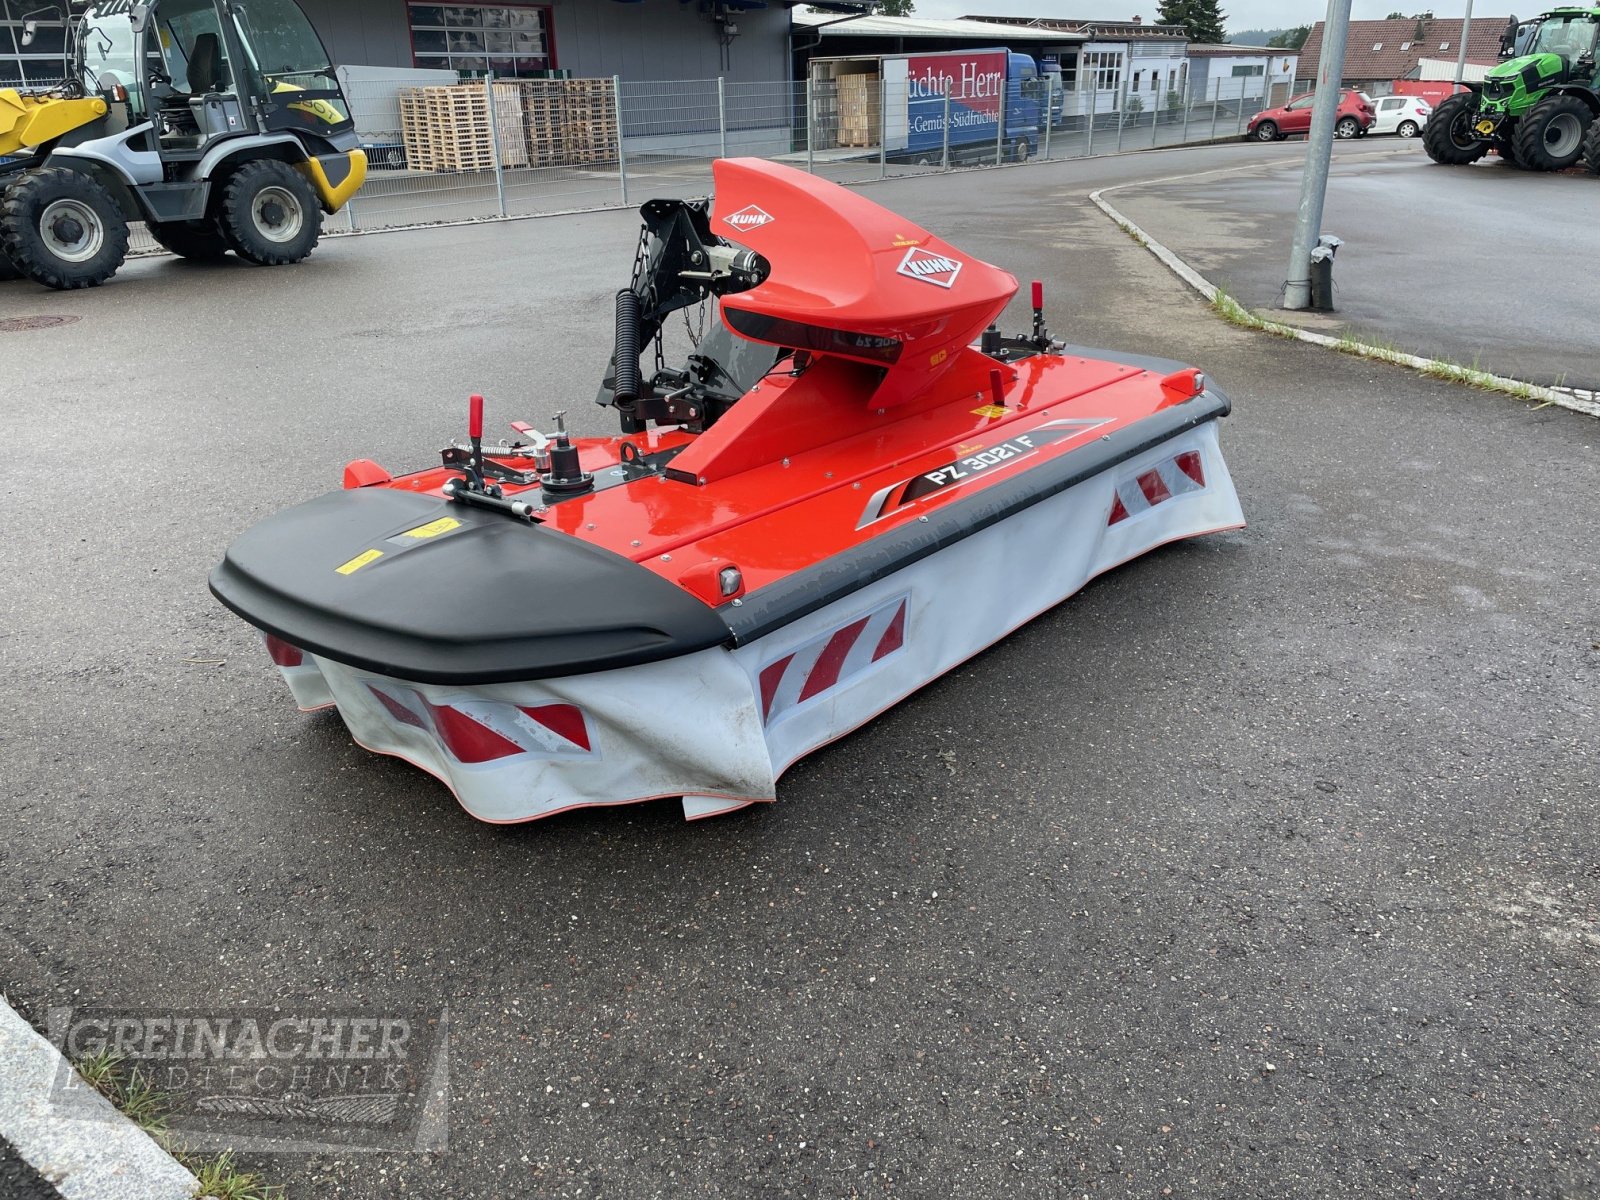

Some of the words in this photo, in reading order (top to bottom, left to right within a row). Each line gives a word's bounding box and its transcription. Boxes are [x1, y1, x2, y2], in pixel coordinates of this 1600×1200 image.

[960, 62, 1001, 98] Herr
[730, 214, 767, 225] KUHN
[906, 257, 956, 276] KUHN
[924, 465, 968, 485] PZ
[962, 443, 1022, 470] 3021
[1014, 435, 1034, 448] F
